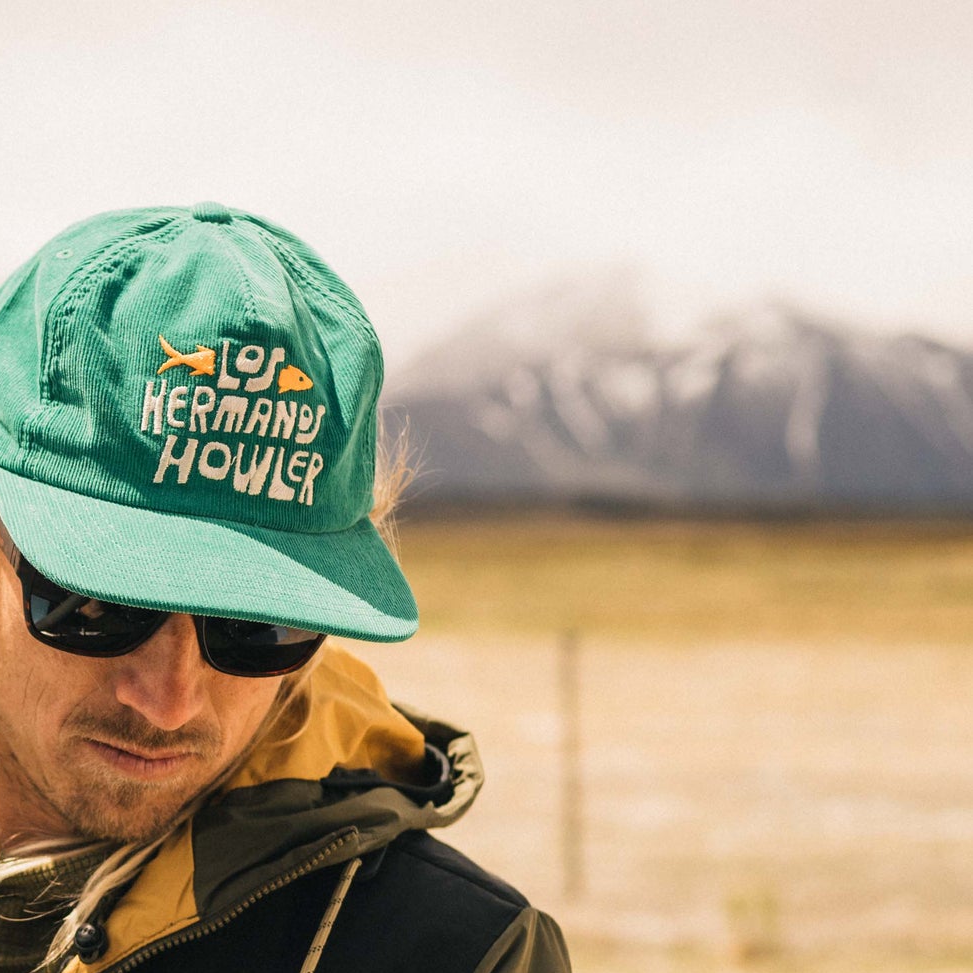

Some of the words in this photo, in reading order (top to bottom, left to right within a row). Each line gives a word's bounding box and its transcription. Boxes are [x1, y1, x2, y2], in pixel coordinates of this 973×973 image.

[218, 341, 285, 392] LOS
[141, 379, 325, 444] HERMANOS
[153, 435, 324, 505] HOWLER
